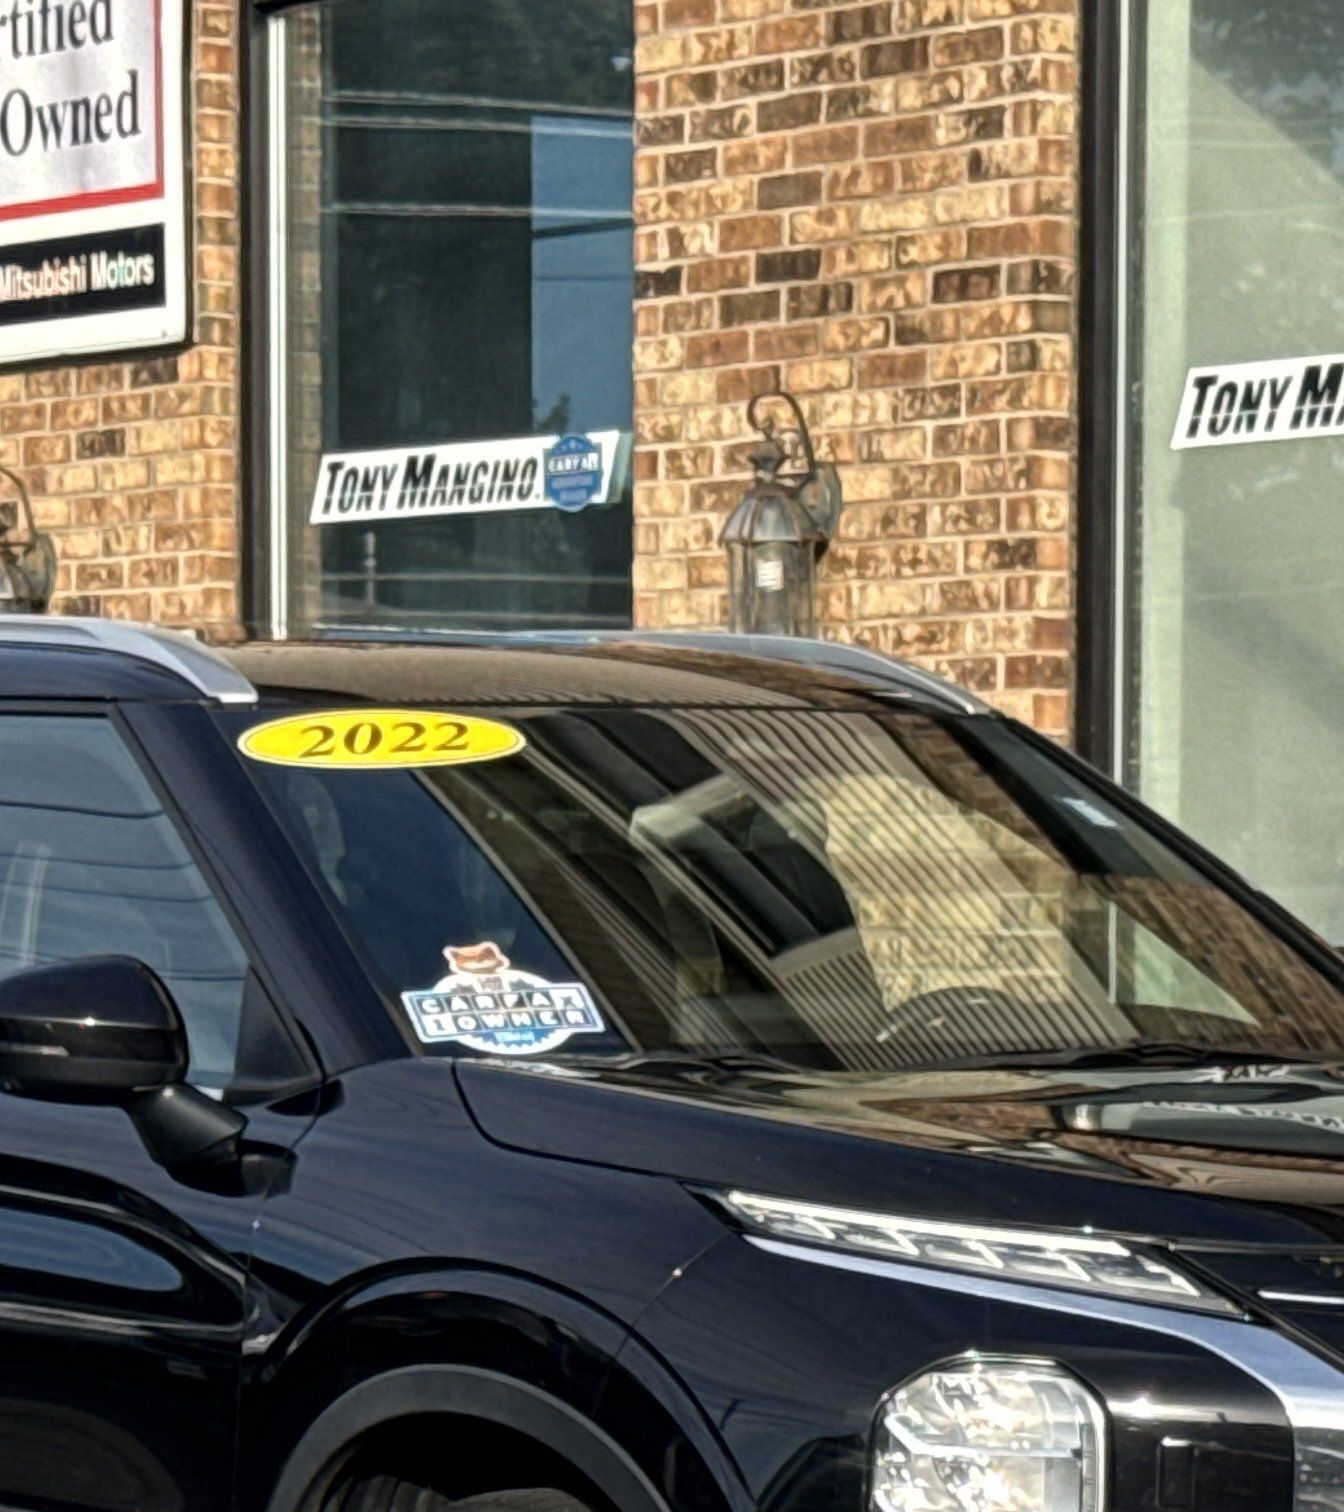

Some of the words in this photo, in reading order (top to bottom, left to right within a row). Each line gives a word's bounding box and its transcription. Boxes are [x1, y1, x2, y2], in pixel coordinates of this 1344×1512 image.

[91, 250, 155, 291] Motors
[1185, 374, 1293, 439] TONY
[321, 460, 399, 515] TONY
[297, 721, 470, 758] 2022
[421, 990, 581, 1016] CARFAX
[458, 1009, 588, 1032] OWNER
